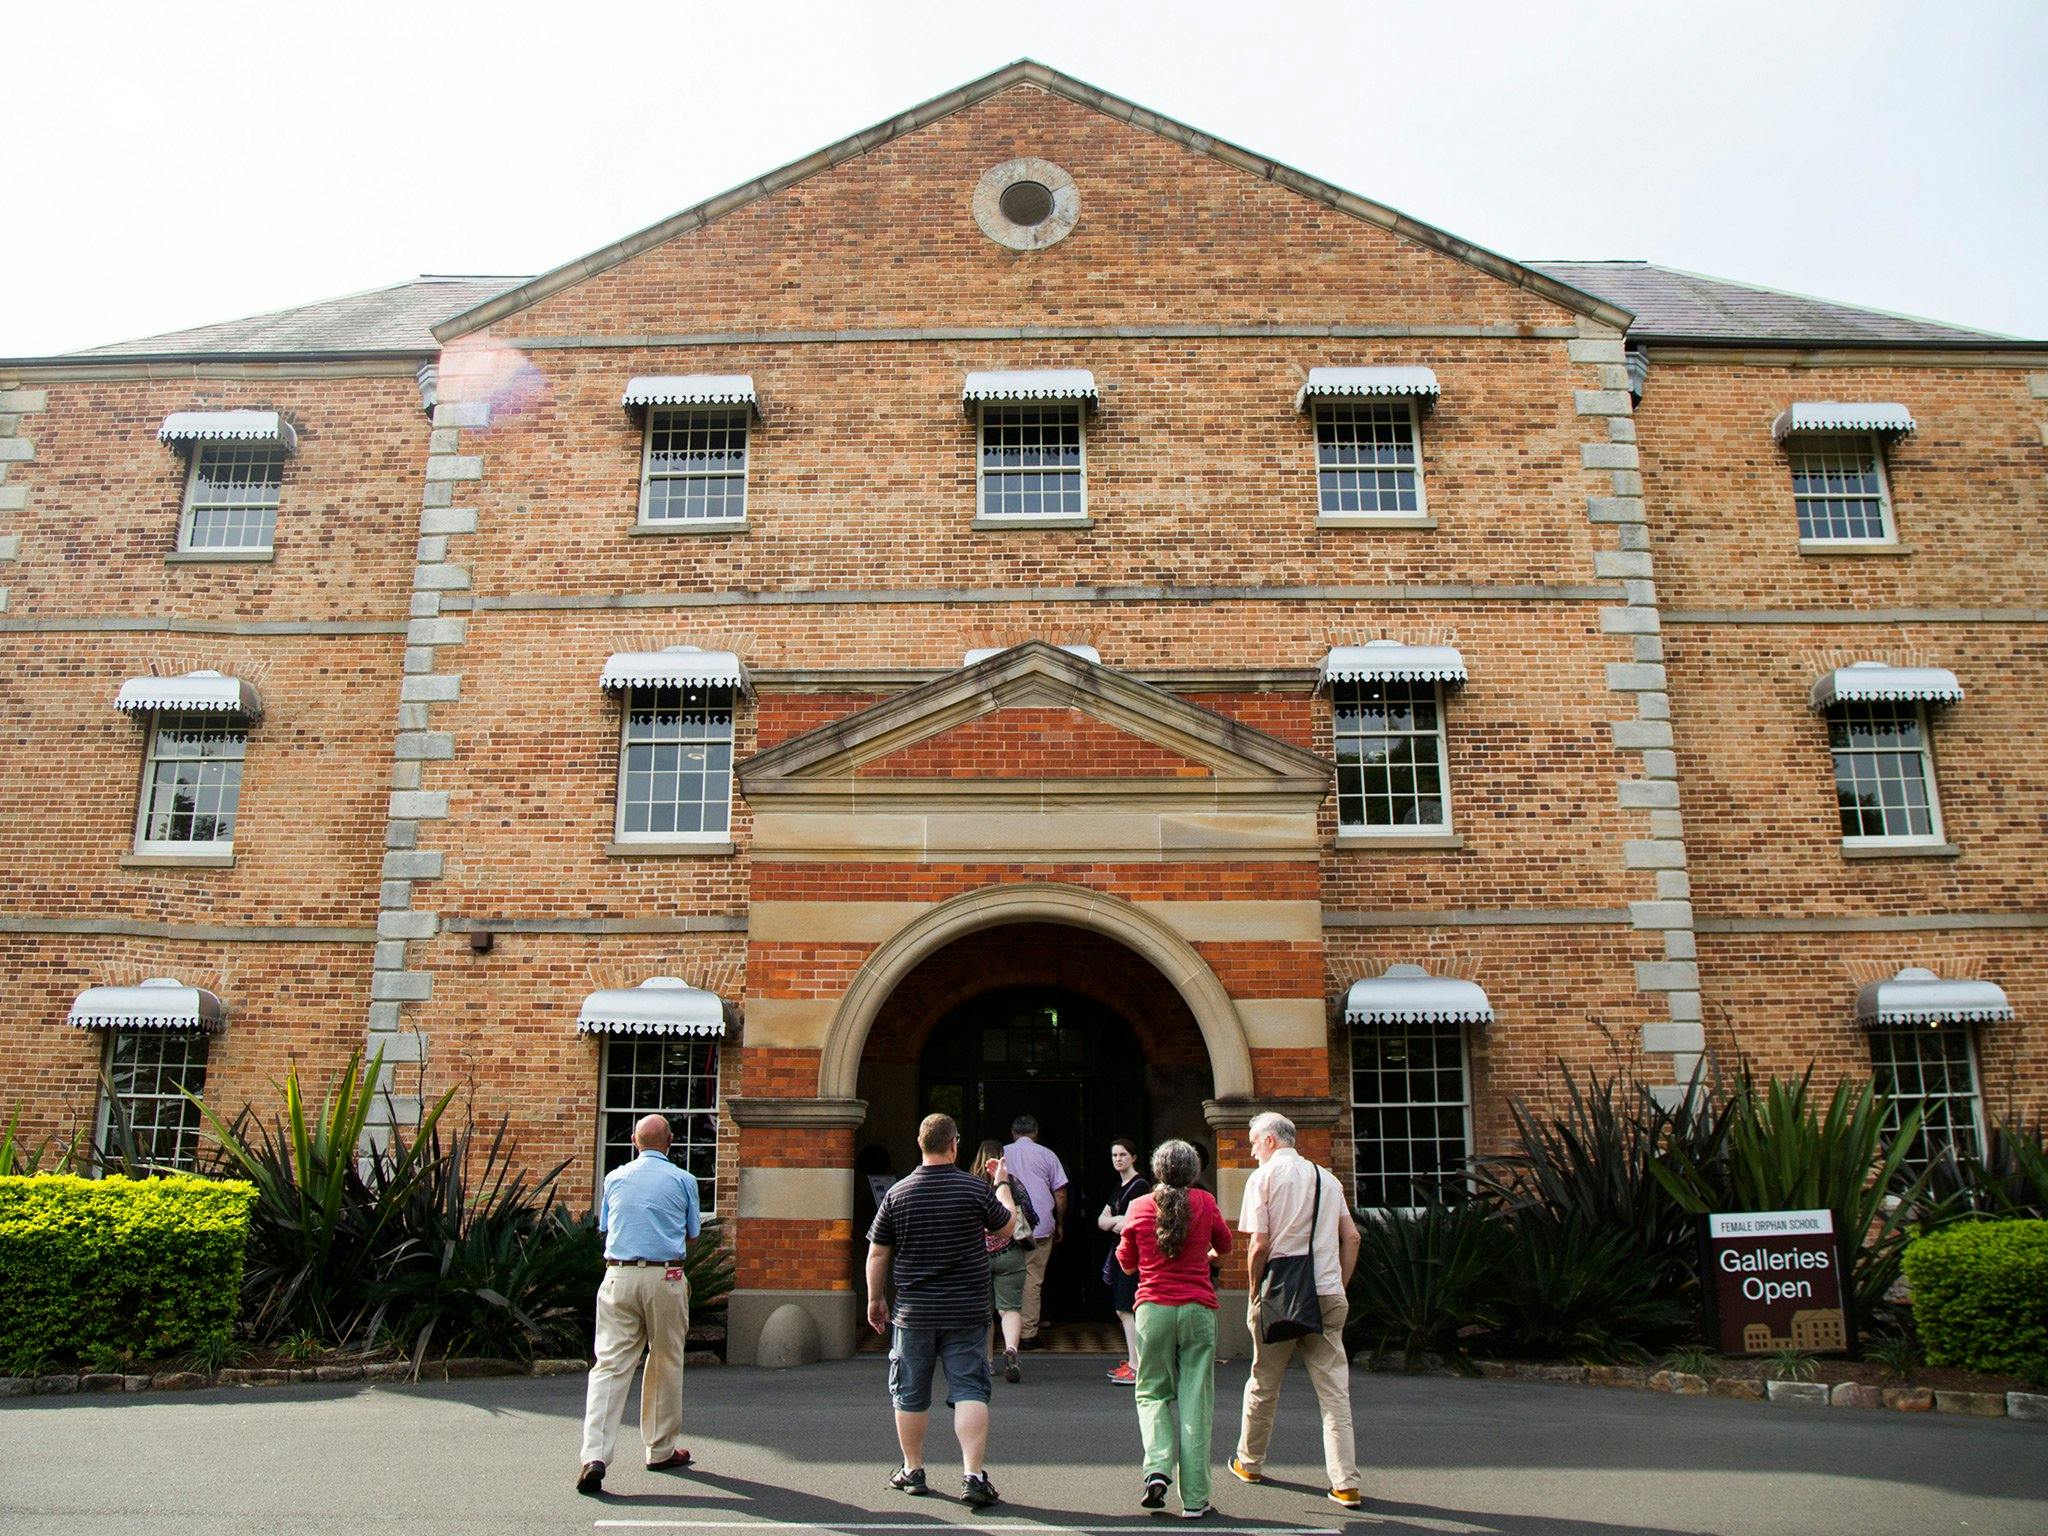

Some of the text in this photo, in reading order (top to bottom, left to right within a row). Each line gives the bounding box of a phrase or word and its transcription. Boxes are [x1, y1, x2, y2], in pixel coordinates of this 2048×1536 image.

[1721, 1219, 1820, 1232] FEMALE ORPHAN SCHOOL
[1720, 1247, 1829, 1273] Galleries
[1743, 1277, 1812, 1305] Open
